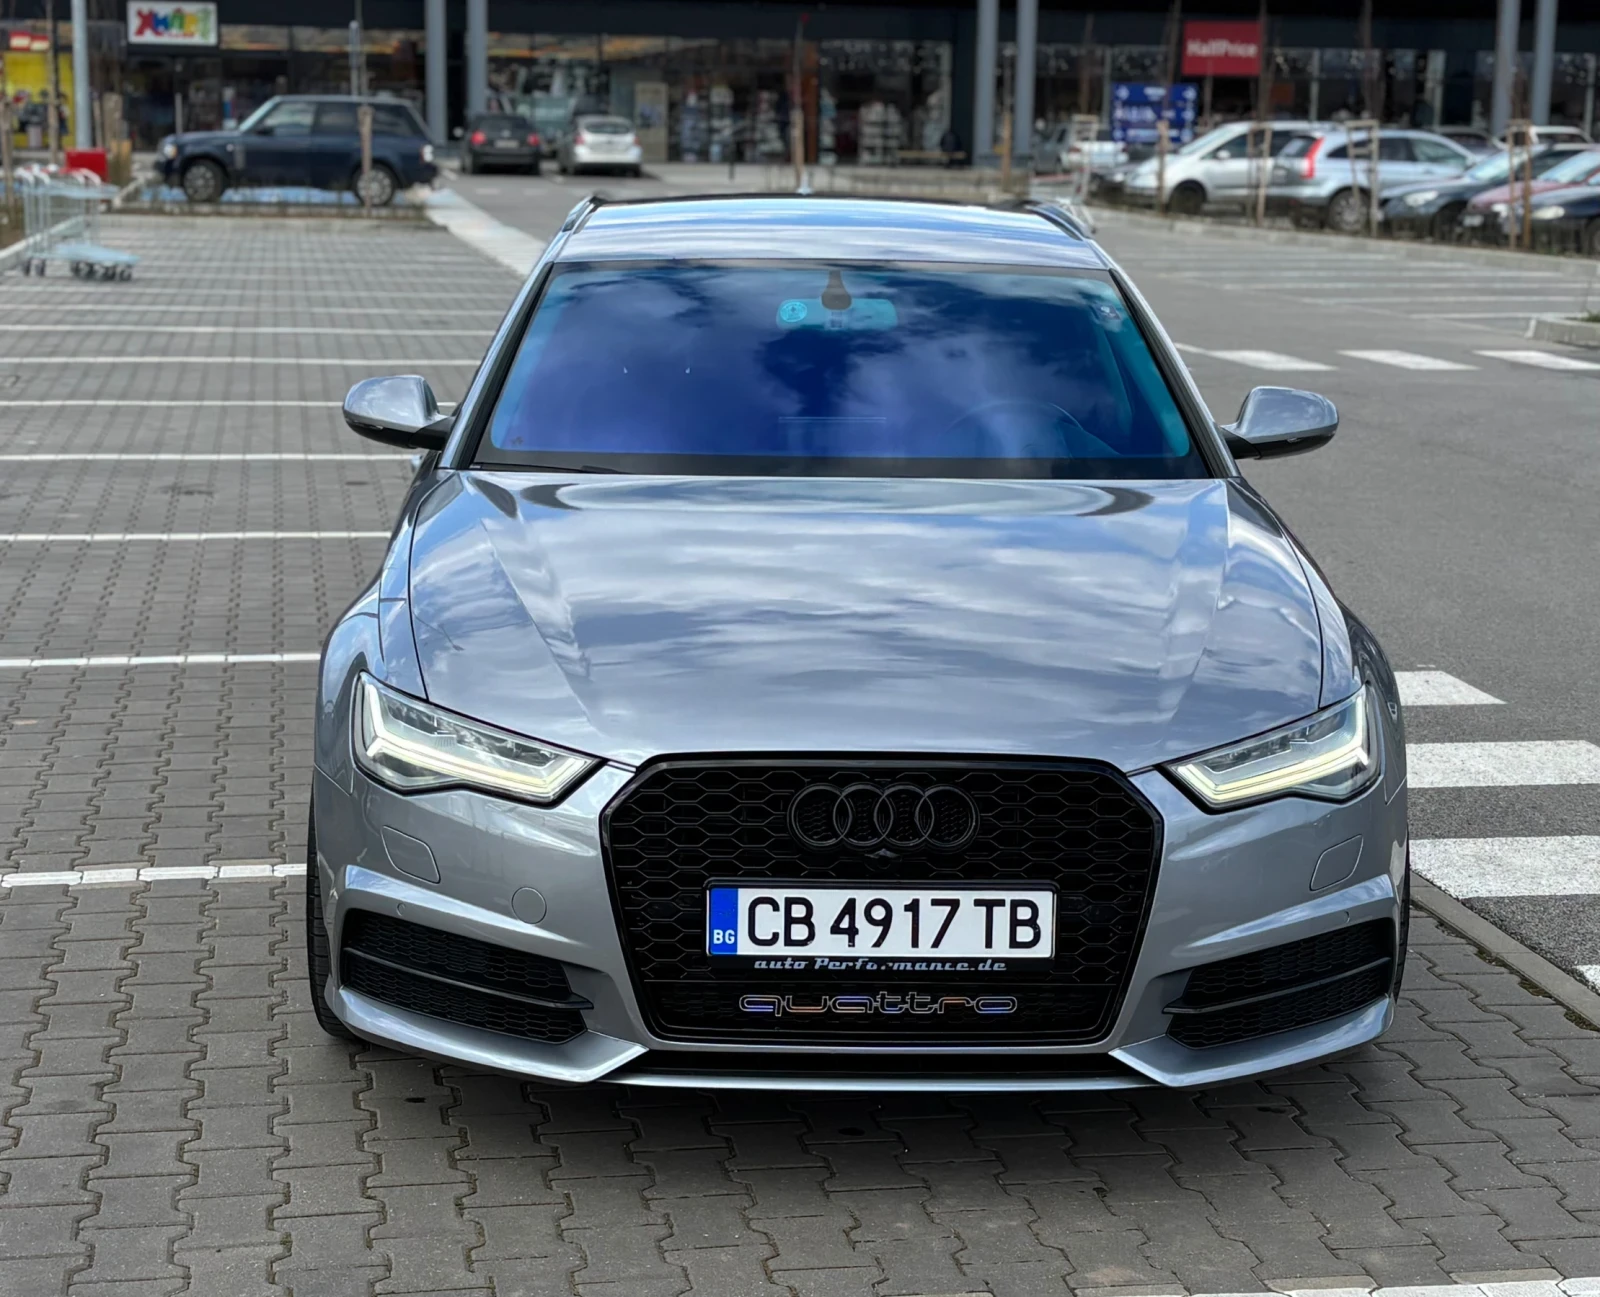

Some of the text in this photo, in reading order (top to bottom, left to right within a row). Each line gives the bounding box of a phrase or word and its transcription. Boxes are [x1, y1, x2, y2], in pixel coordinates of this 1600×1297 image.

[748, 896, 1041, 949] CB 4917 TB
[713, 929, 735, 944] BG
[754, 957, 809, 969] auto
[739, 991, 1018, 1017] quattro
